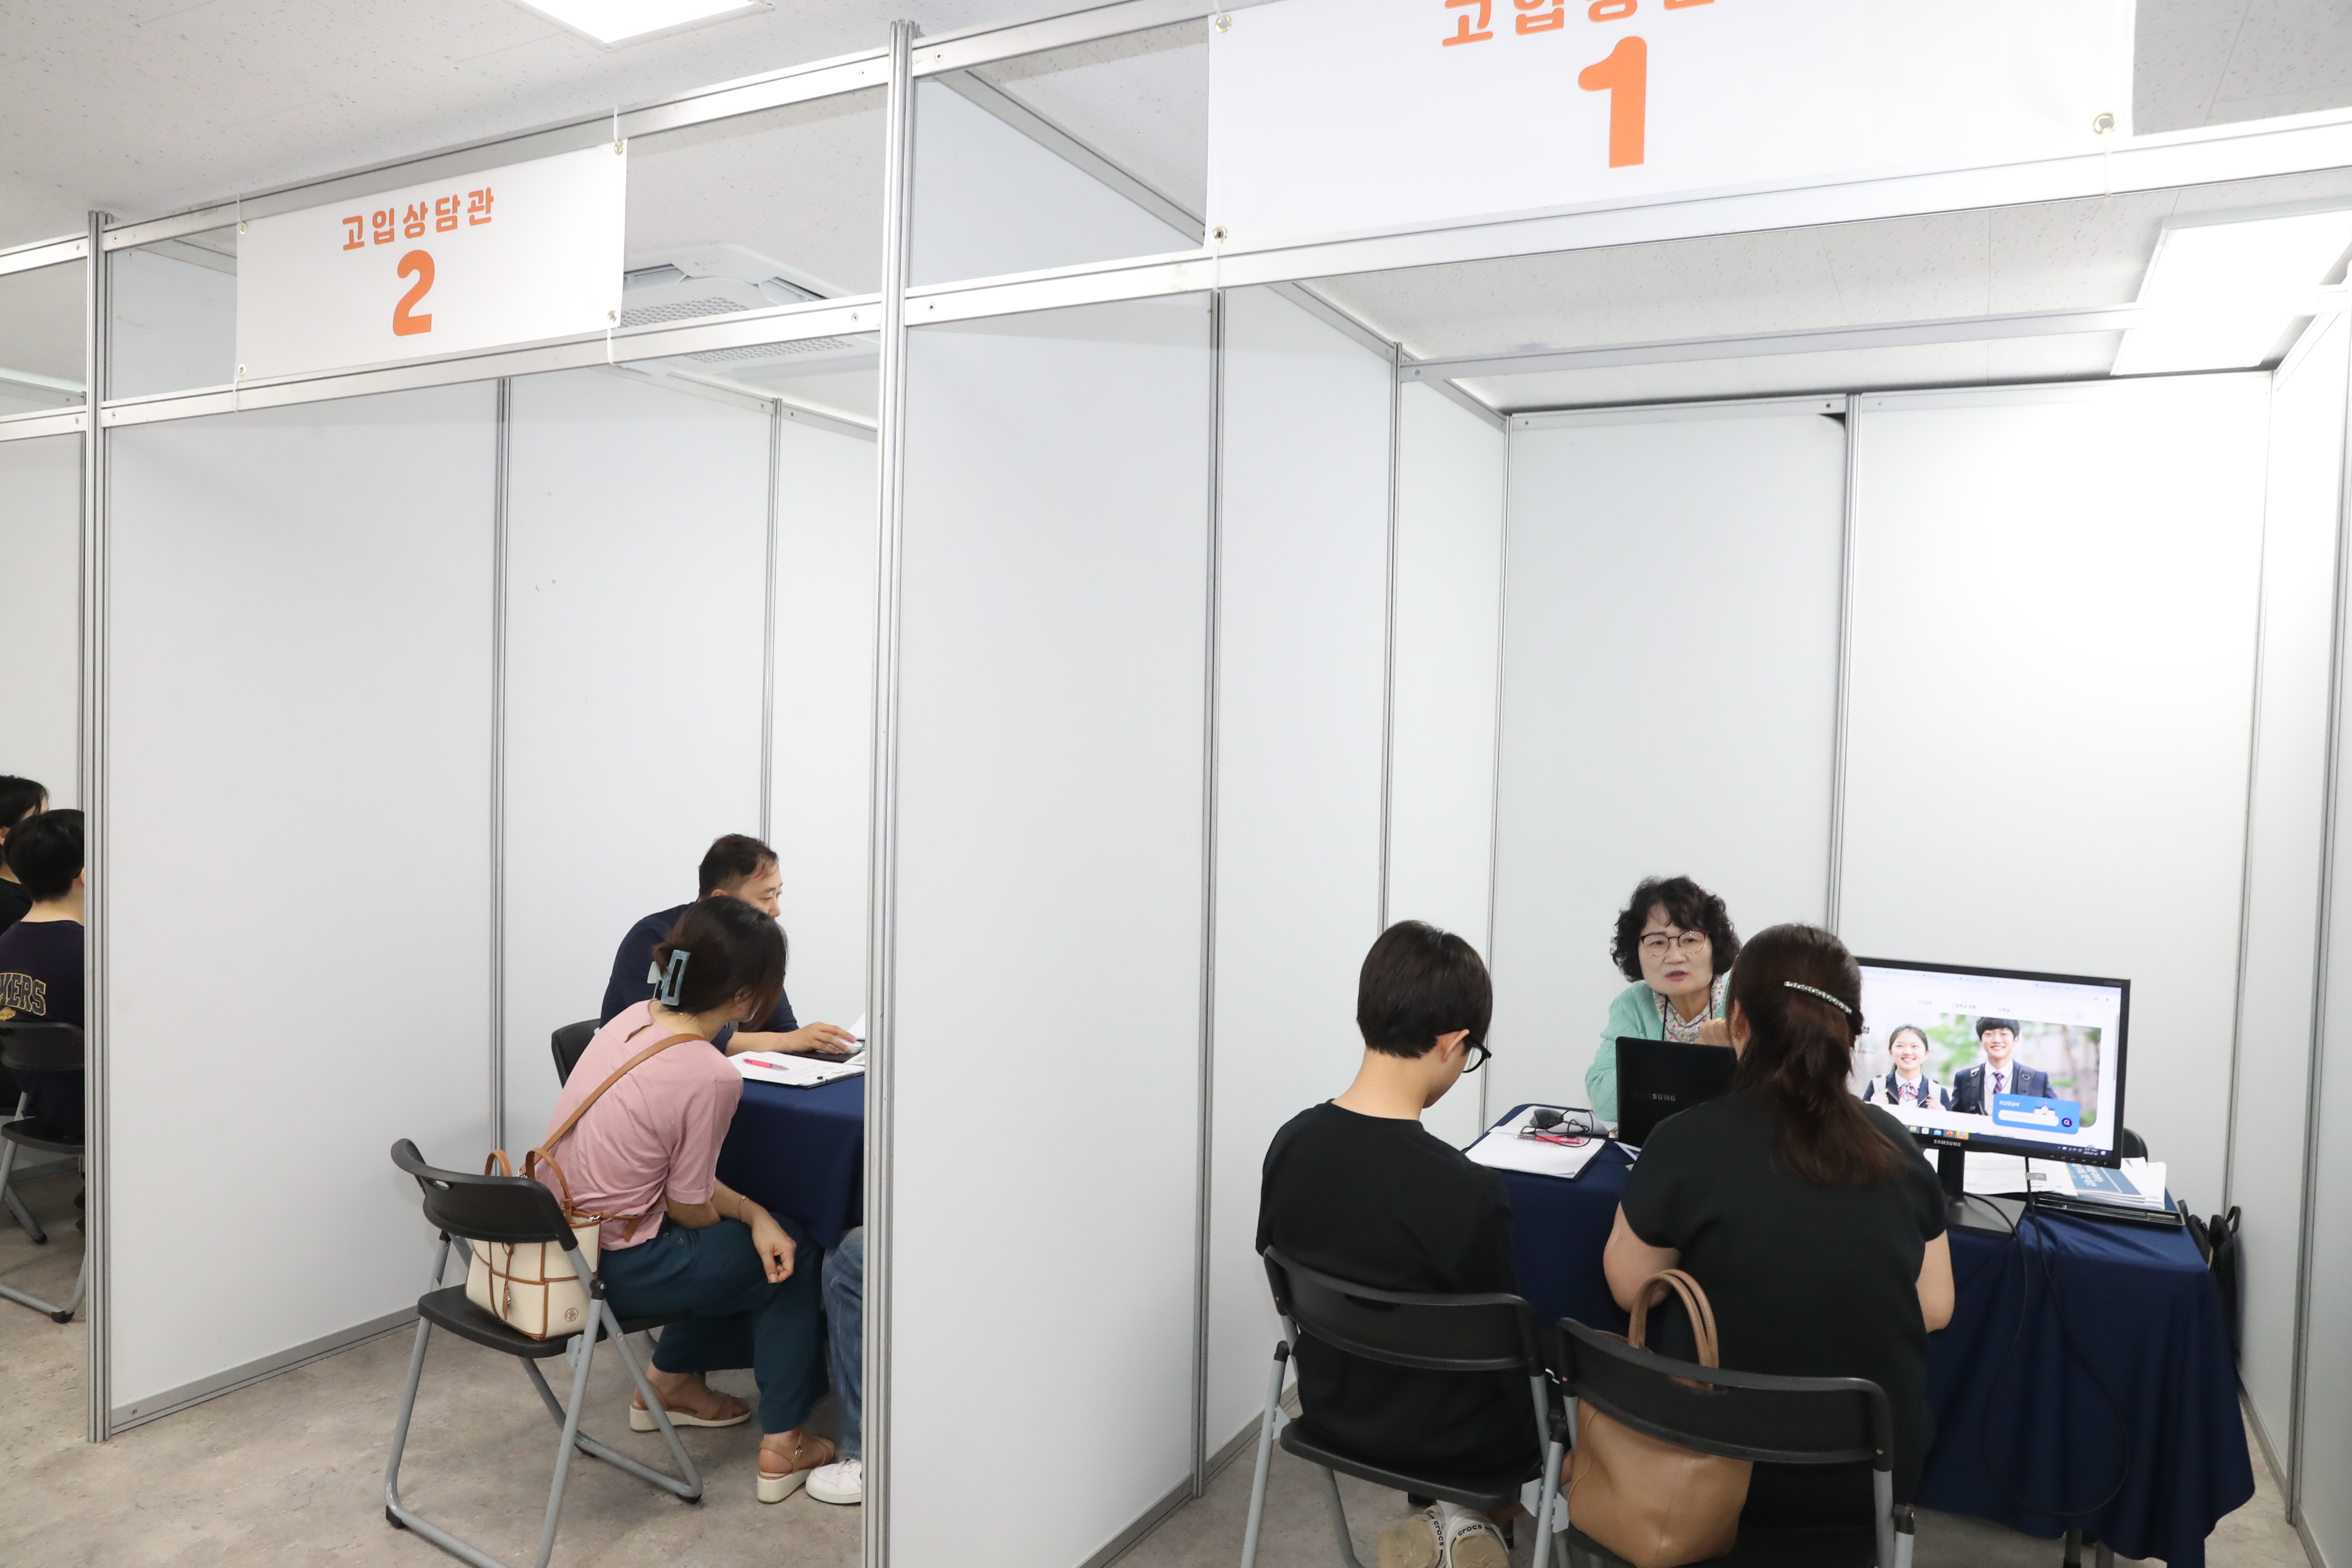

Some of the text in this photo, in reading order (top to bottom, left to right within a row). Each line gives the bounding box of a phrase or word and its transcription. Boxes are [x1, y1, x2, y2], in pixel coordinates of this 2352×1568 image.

[1578, 36, 1647, 169] 1
[342, 187, 494, 251] 고입상담관
[392, 250, 435, 337] 2
[1934, 1139, 1961, 1147] SAMSUNG
[1433, 1520, 1444, 1546] crocs
[1458, 1524, 1482, 1536] crocs
